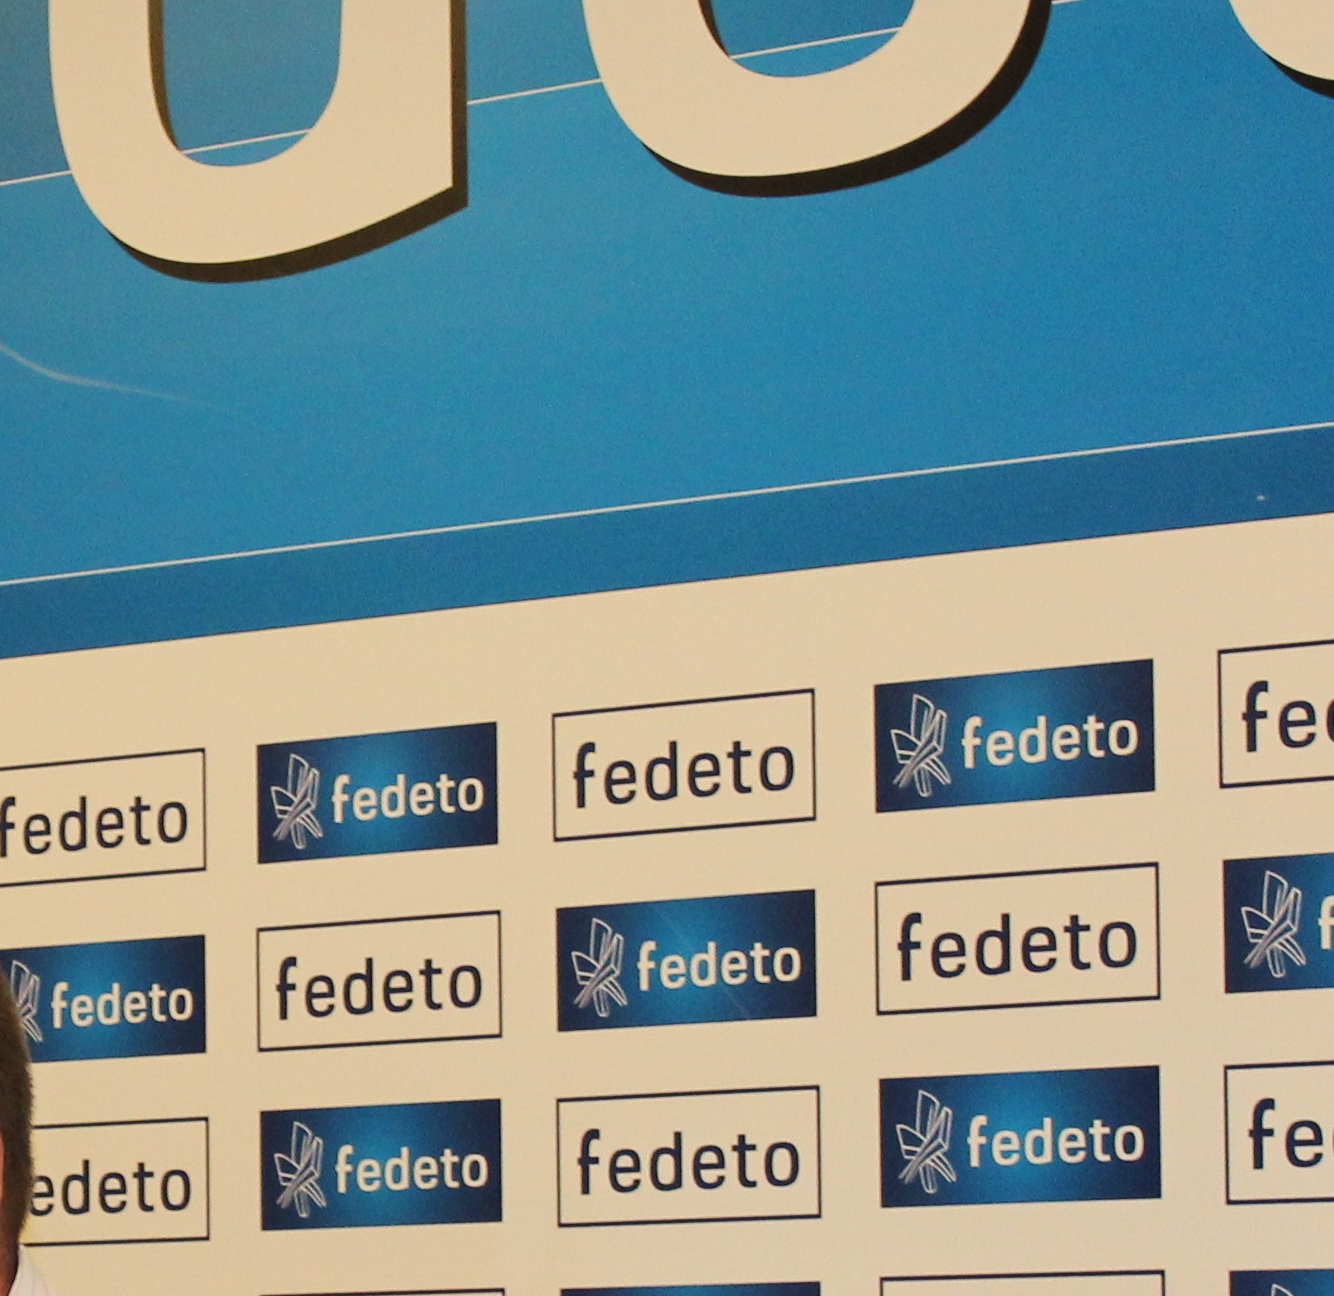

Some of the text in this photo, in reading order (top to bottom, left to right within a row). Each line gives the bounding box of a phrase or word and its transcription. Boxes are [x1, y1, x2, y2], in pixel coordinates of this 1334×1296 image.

[961, 714, 1138, 769] fedeto
[331, 773, 484, 824] fedeto
[573, 740, 795, 809] fedeto
[636, 940, 801, 992] fedeto
[897, 911, 1137, 982] fedeto
[50, 981, 193, 1029] fedeto
[275, 956, 482, 1021] fedeto
[334, 1143, 488, 1194] fedeto
[577, 1128, 800, 1195] fedeto
[966, 1114, 1144, 1168] fedeto
[29, 1159, 191, 1217] edeto
